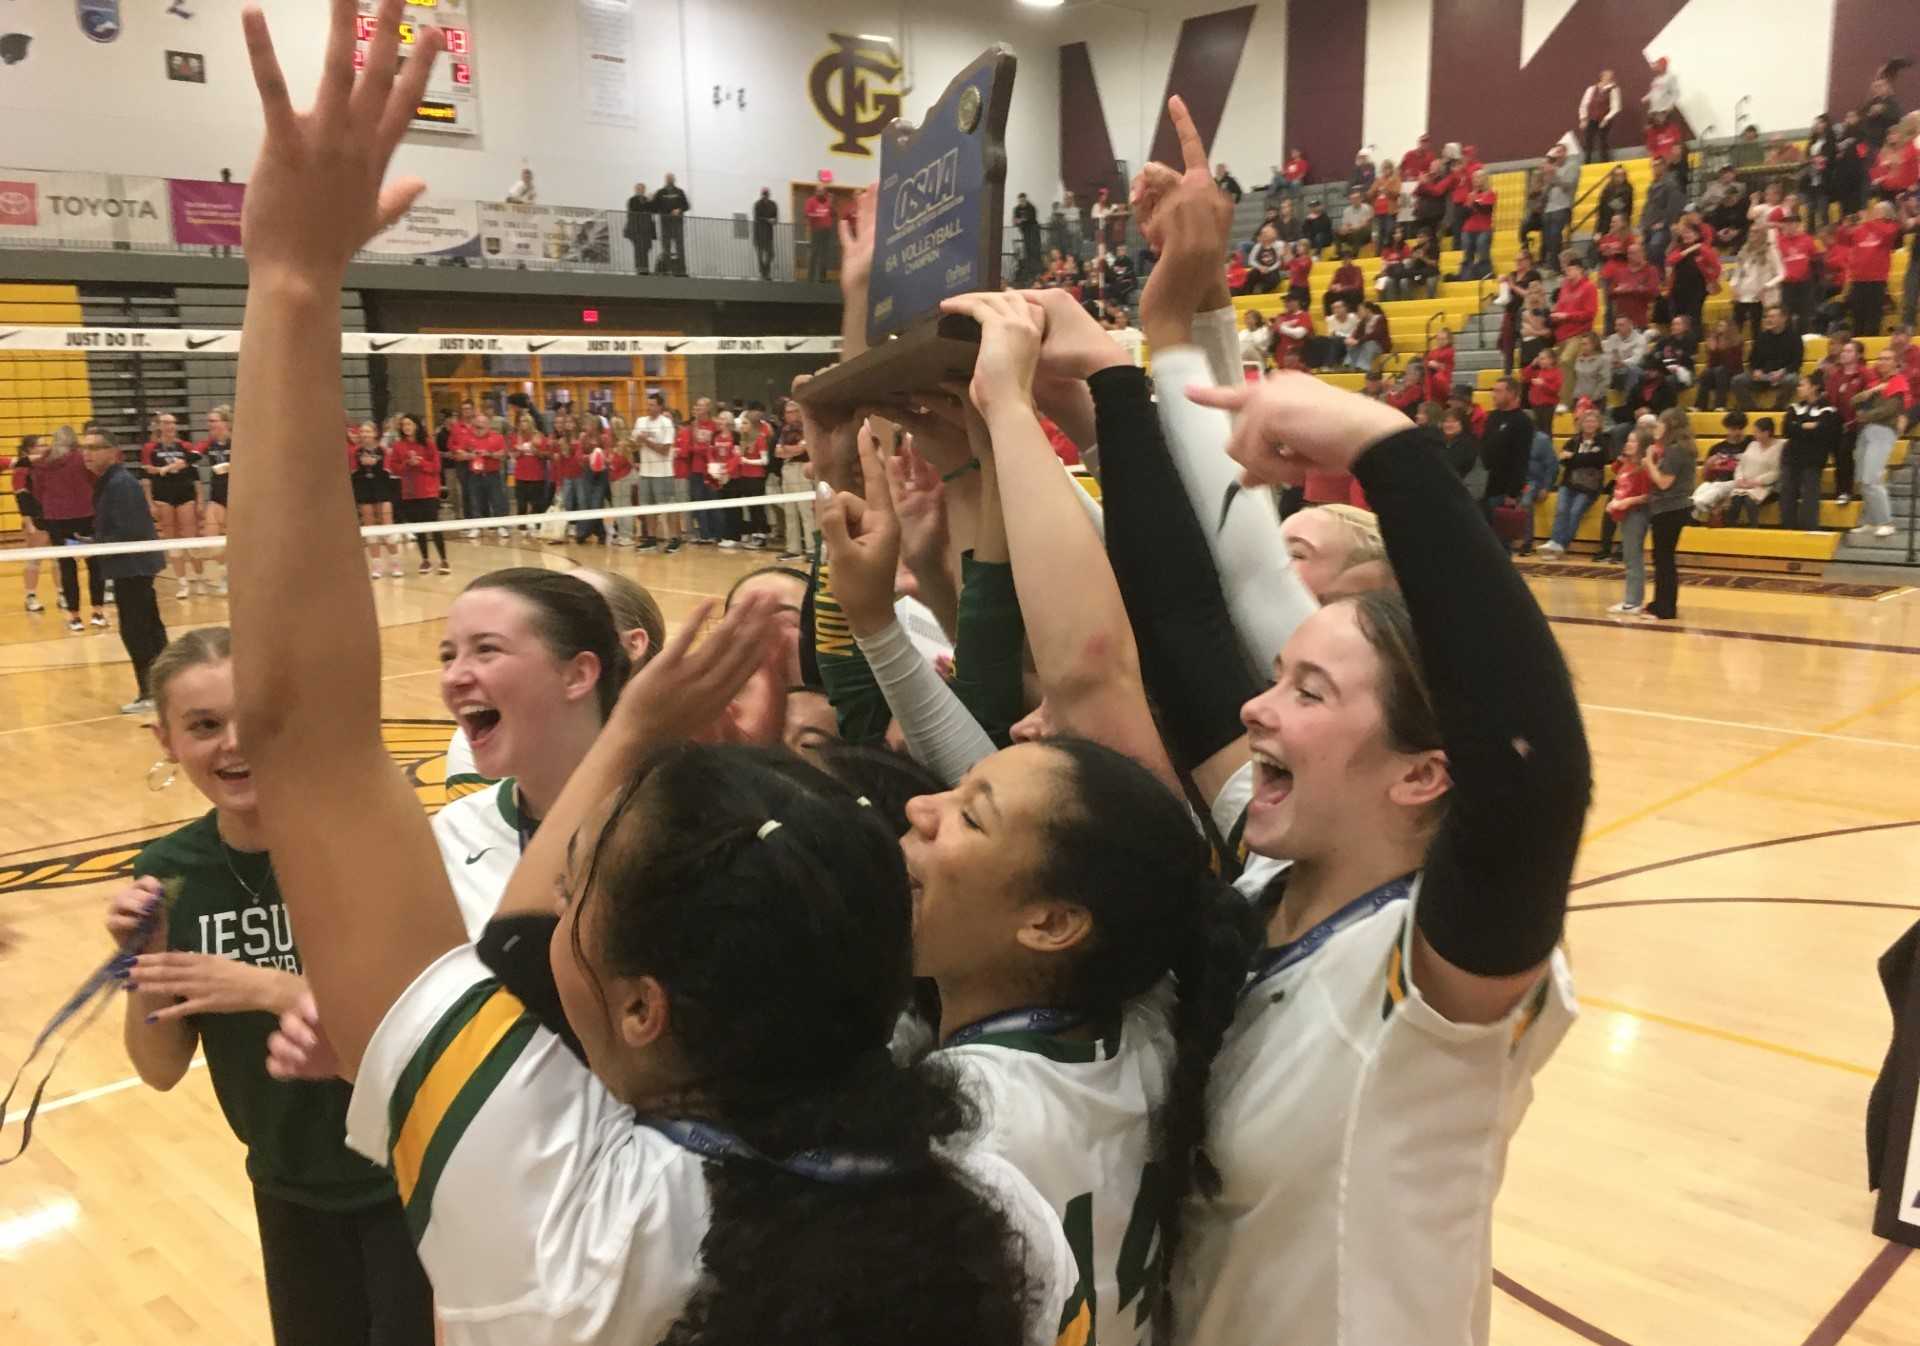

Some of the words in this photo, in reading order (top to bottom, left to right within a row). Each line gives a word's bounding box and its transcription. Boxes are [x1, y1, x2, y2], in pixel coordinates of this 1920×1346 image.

[398, 23, 416, 44] 5
[446, 29, 468, 53] 13
[456, 63, 471, 86] 2
[46, 195, 158, 220] TOYOTA
[901, 218, 964, 262] VOLLEYBALL
[65, 332, 100, 347] JUST
[105, 332, 126, 347] DO
[438, 338, 464, 350] JUST
[468, 338, 484, 350] DO
[587, 340, 611, 352] JUST
[614, 340, 627, 352] DO
